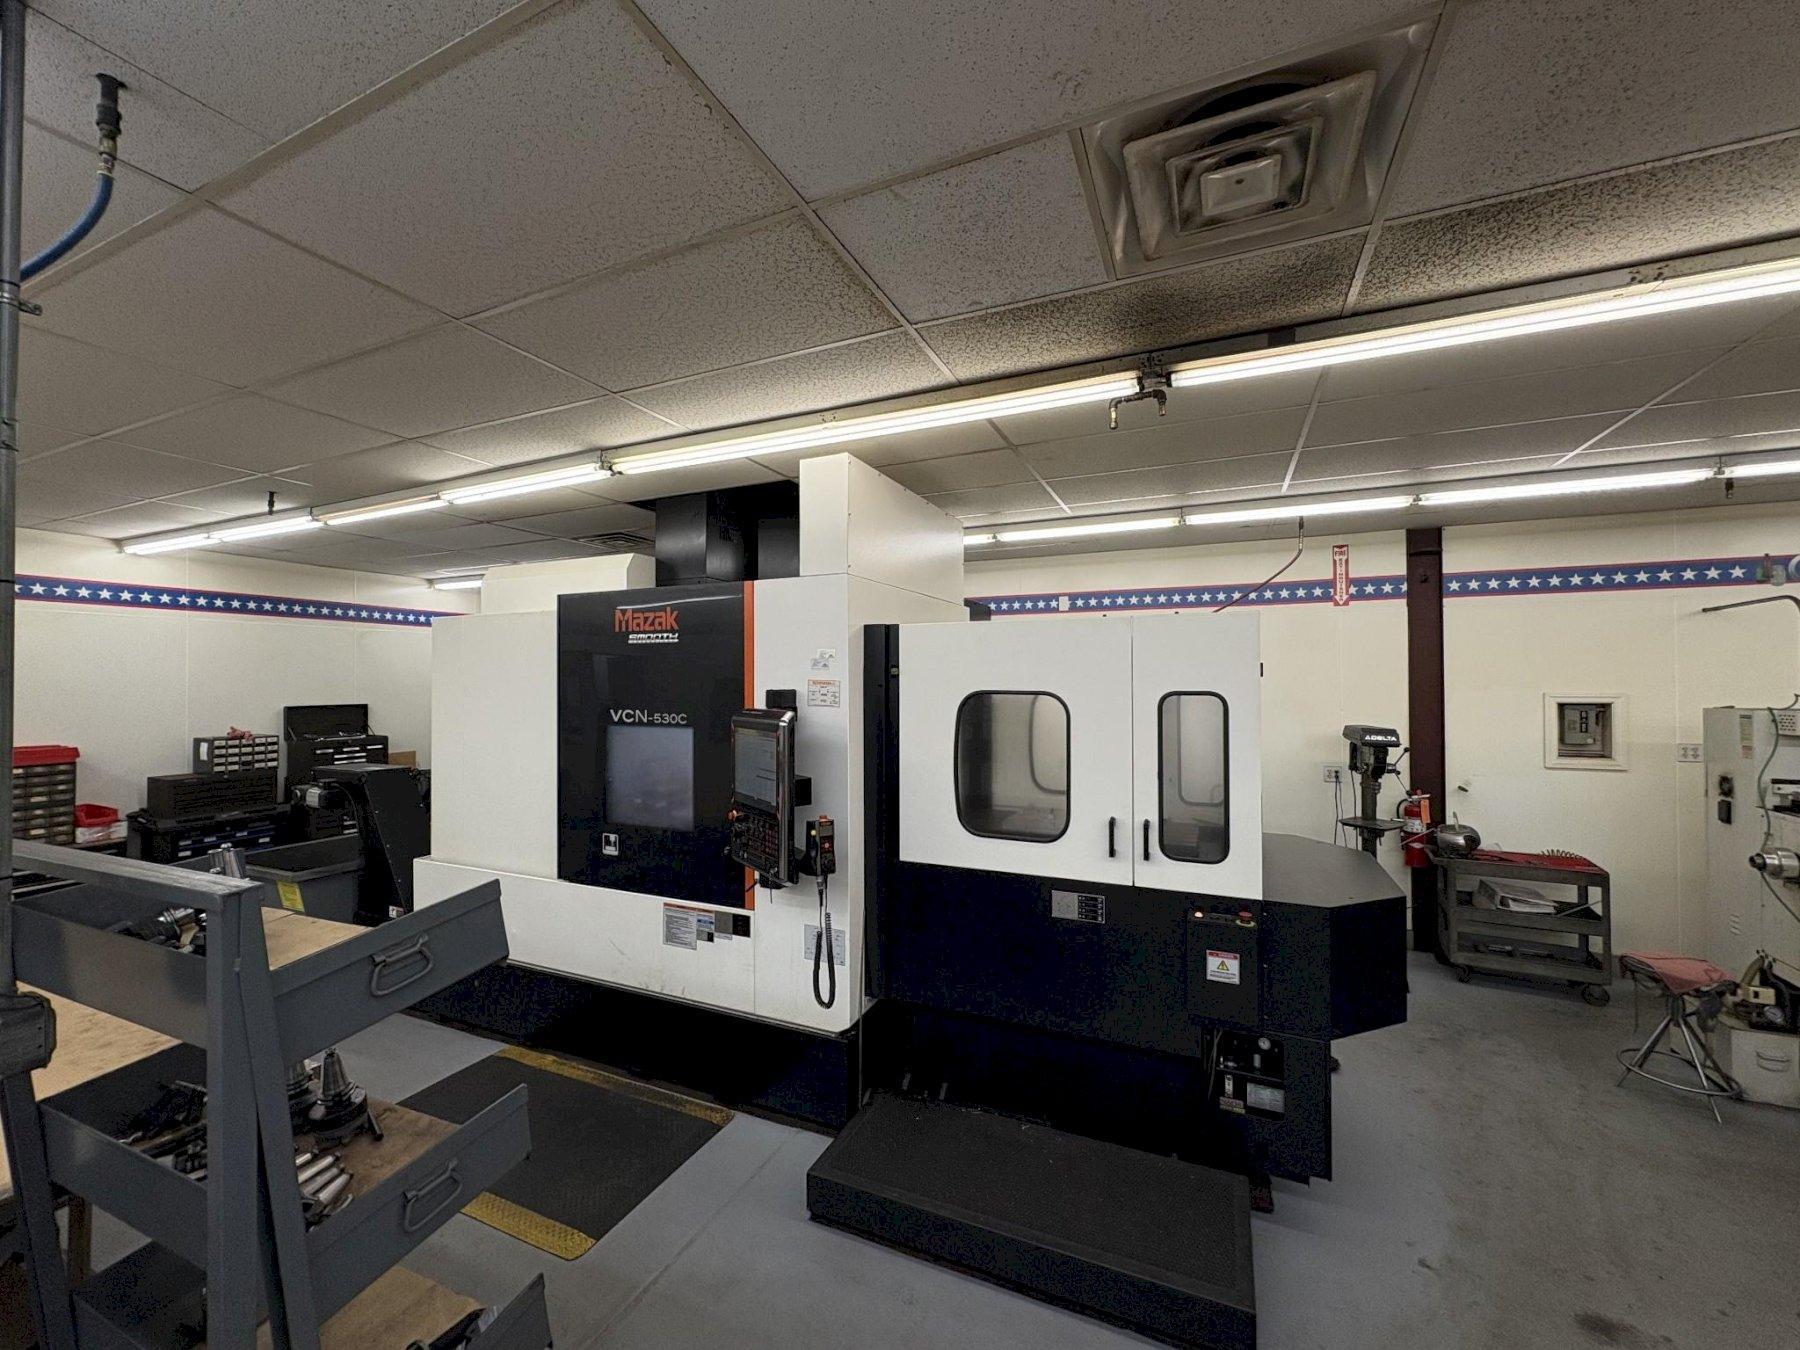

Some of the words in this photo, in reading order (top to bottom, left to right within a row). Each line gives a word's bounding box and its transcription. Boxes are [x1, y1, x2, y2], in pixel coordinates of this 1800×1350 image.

[614, 606, 679, 632] Mazak
[628, 632, 679, 641] SMOOTH
[609, 709, 688, 724] VCN-530C
